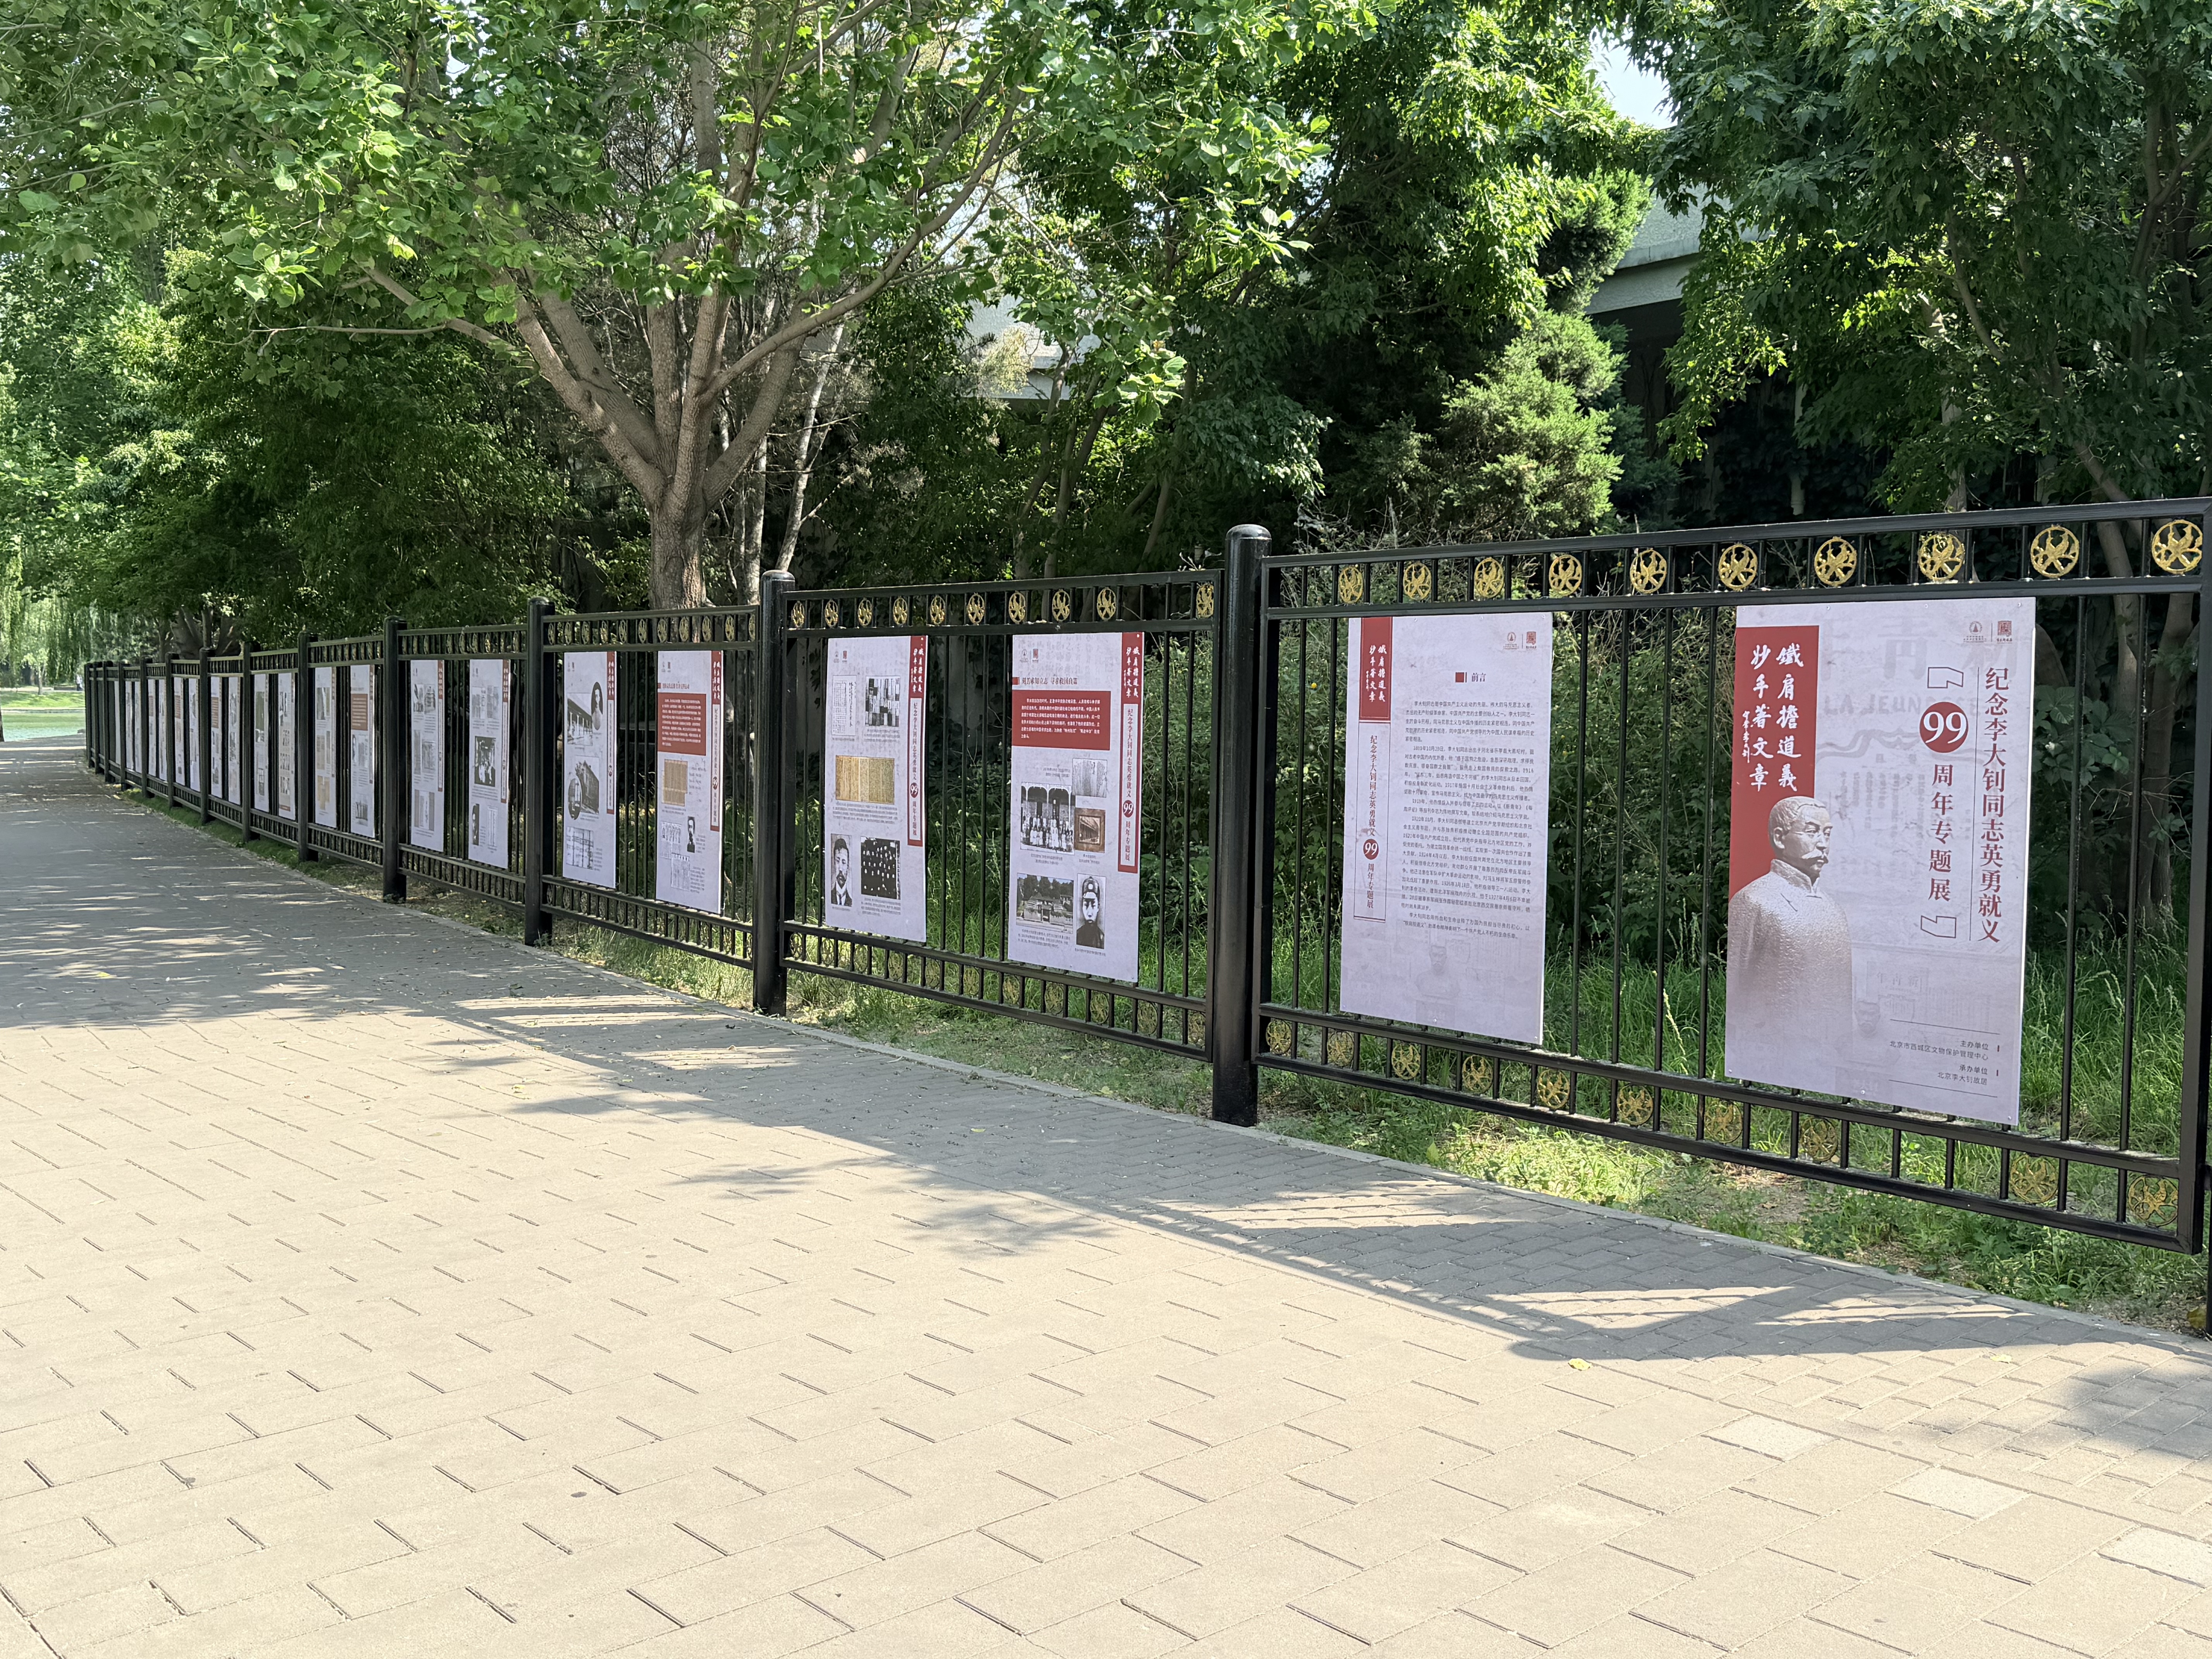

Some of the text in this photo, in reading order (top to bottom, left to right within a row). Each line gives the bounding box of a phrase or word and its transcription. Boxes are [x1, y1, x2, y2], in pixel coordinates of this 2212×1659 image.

[1472, 673, 1486, 682] 前言
[1923, 712, 1968, 744] 99
[1369, 735, 1377, 836] 纪念李大钊同志英勇就义
[1124, 803, 1133, 814] 99
[1978, 667, 2009, 943] 纪念李大钊同志英勇就义
[1928, 763, 1954, 902] 周年专题展
[1365, 842, 1377, 855] 99
[1889, 1041, 1988, 1060] 北京市西城区文物保护管理中心
[1960, 1041, 1989, 1050] 主办单位
[1959, 1064, 1988, 1075] 承办单位
[1937, 1072, 1987, 1085] 北京李大钊故居
